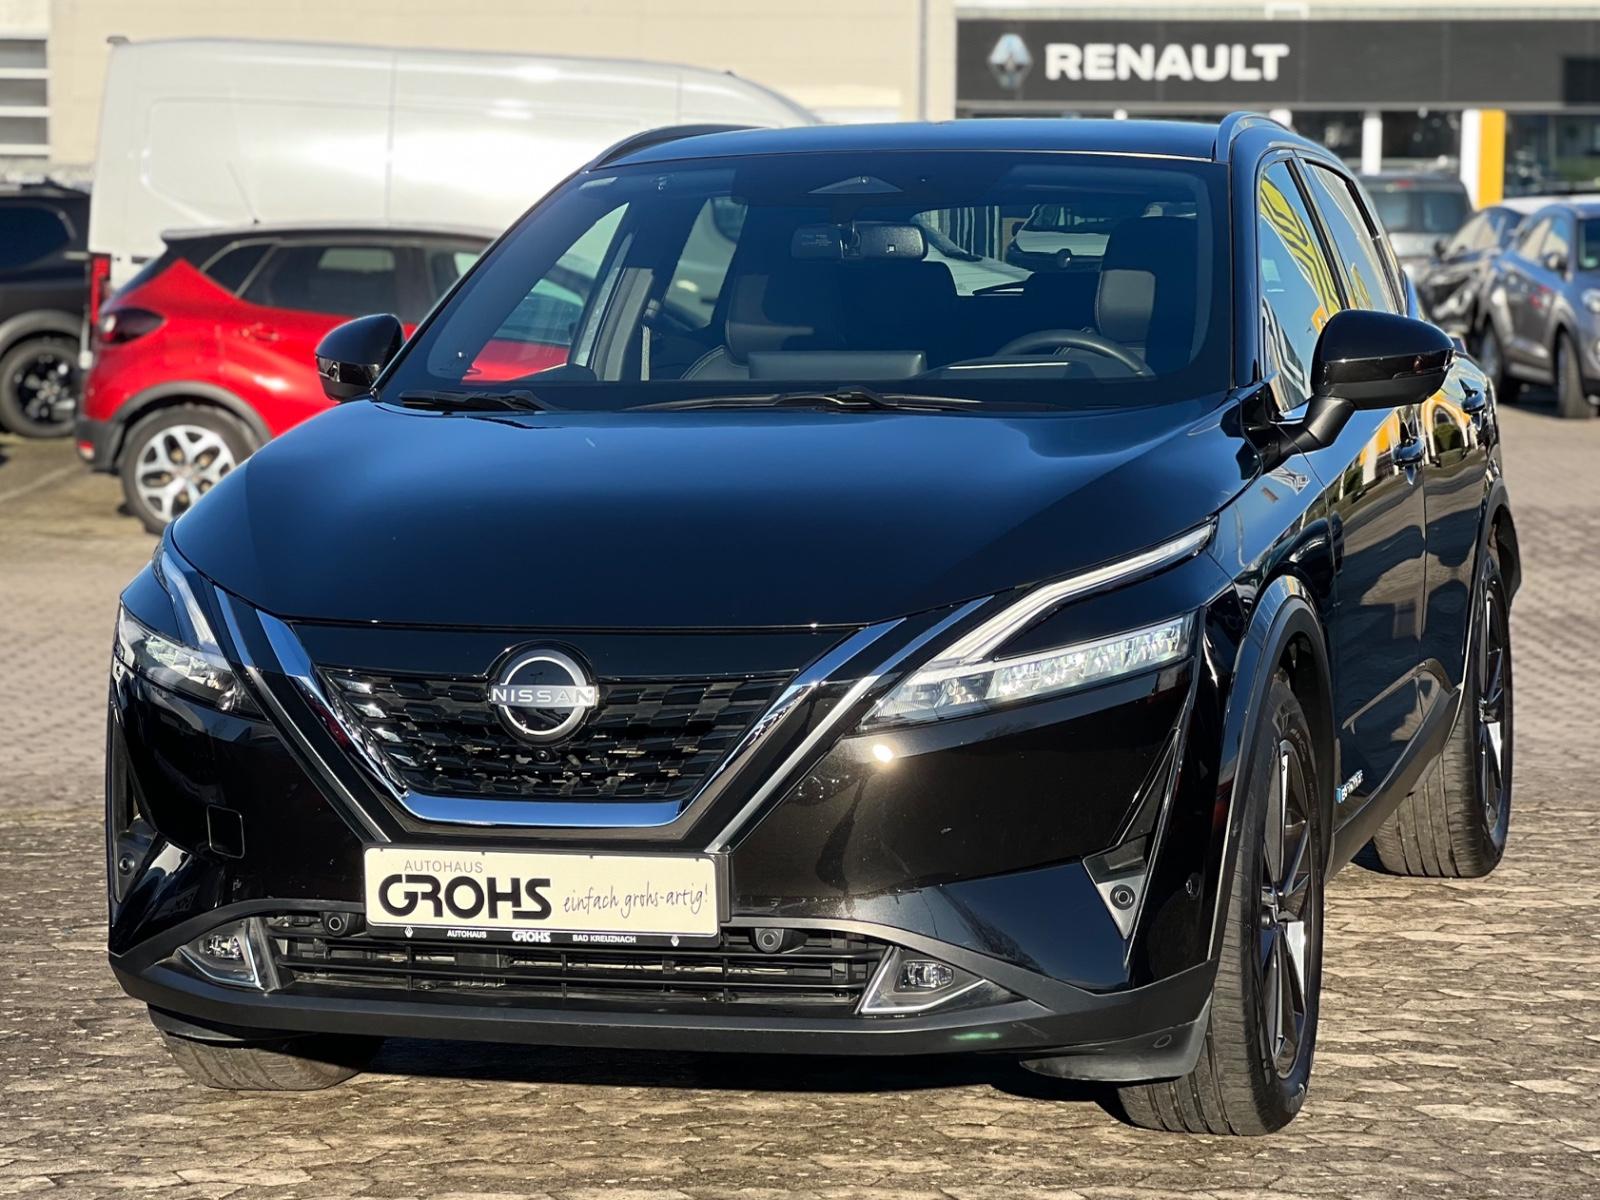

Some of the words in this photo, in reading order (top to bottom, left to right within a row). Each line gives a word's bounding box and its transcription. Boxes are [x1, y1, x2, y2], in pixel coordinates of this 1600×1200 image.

[1045, 43, 1290, 81] RENAULT
[492, 688, 594, 704] NISSAN
[404, 859, 484, 874] AUTOHAUS
[378, 873, 552, 920] GROHS
[563, 886, 619, 914] einfach
[620, 882, 708, 919] grohs-artig!
[447, 930, 487, 939] AUTOHAUS
[512, 931, 551, 943] GROHS
[572, 935, 589, 943] BAD
[590, 935, 637, 944] KREUZNACH
